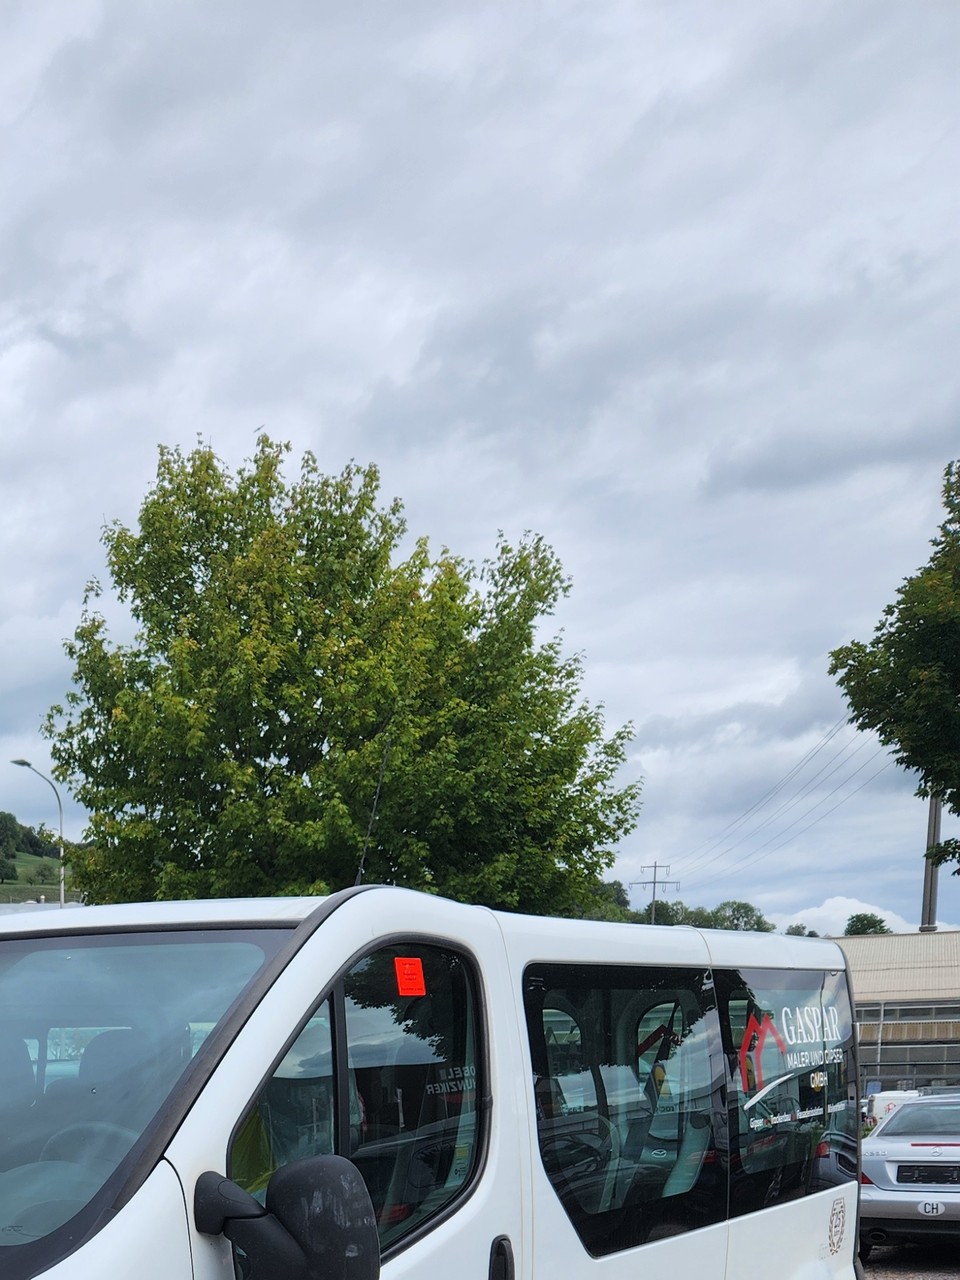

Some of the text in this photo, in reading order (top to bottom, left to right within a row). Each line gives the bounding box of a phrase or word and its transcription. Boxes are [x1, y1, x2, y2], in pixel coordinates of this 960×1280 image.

[781, 1006, 842, 1045] GASPAR
[787, 1052, 810, 1069] MALER
[810, 1050, 824, 1066] UND
[923, 1202, 939, 1214] CH
